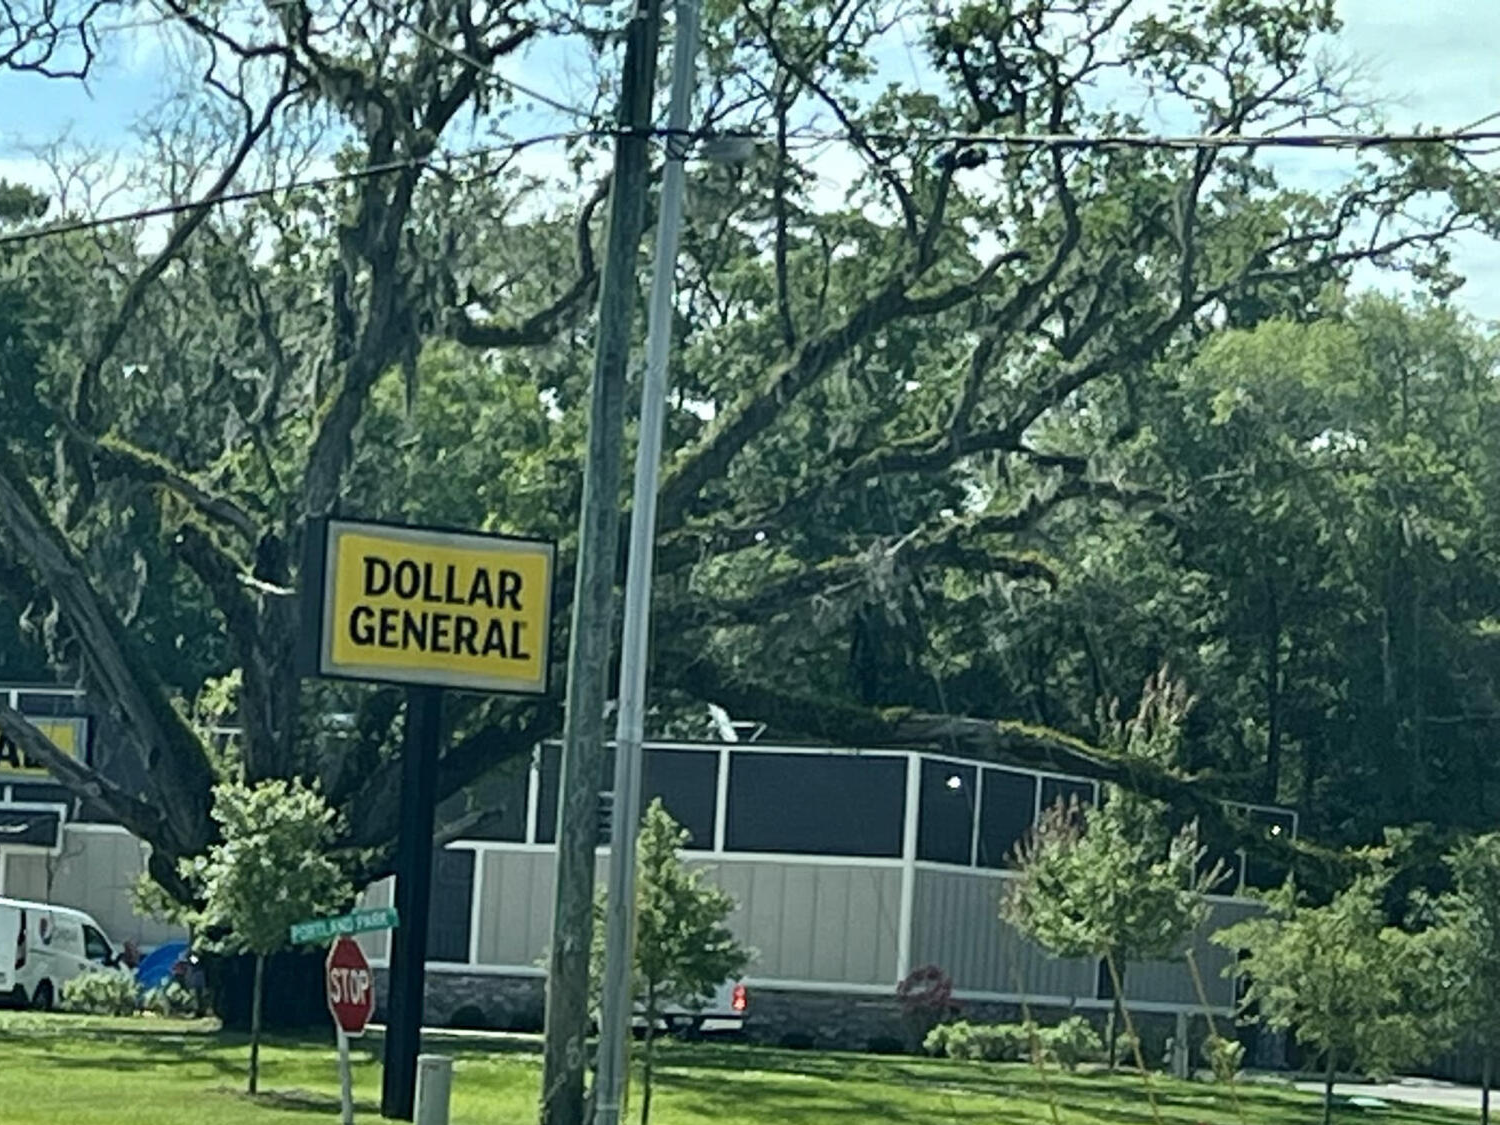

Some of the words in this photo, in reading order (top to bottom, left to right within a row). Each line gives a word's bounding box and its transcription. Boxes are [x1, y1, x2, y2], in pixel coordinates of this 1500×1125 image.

[363, 555, 523, 611] DOLLAR
[349, 605, 530, 661] GENERAL
[330, 967, 369, 1005] STOP
